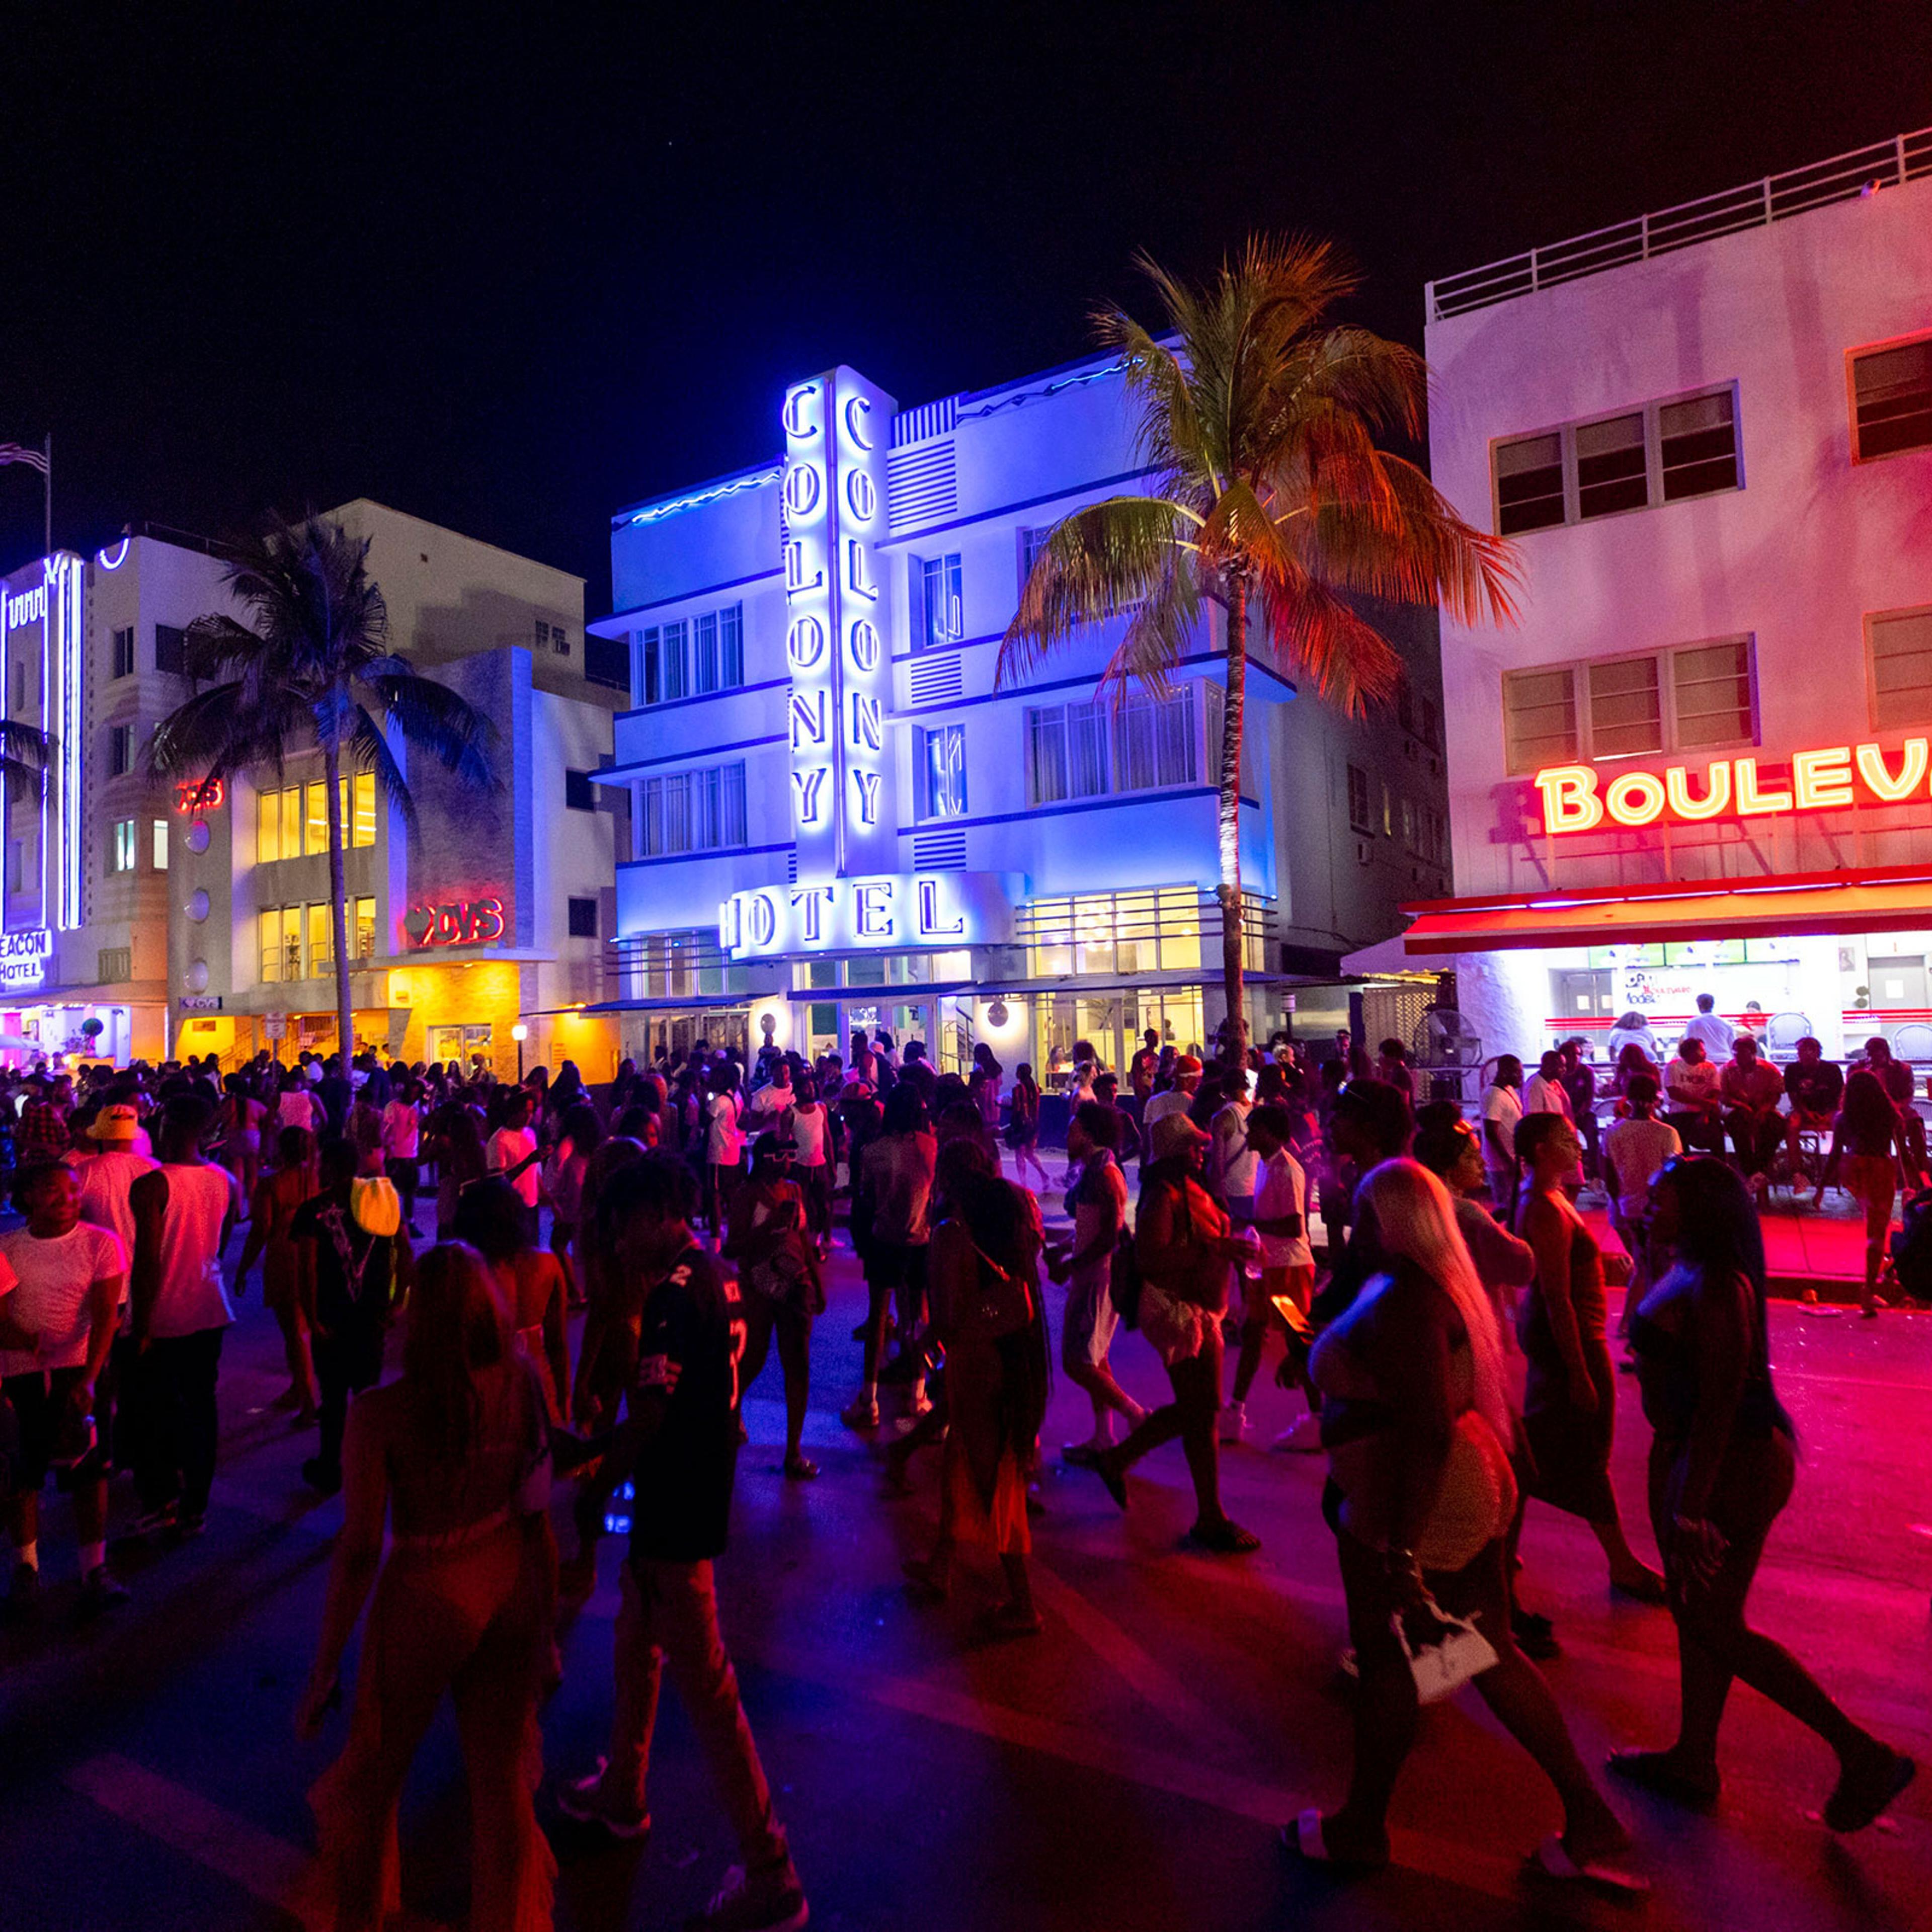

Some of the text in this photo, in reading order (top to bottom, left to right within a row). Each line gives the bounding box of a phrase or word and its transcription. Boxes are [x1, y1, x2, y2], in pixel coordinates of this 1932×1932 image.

[783, 385, 827, 823] COLONY
[845, 396, 882, 825] COLONY
[1535, 738, 1932, 834] BOULEV
[434, 898, 503, 942] CVS
[719, 880, 963, 948] HOTEL
[0, 961, 40, 980] HOTEL
